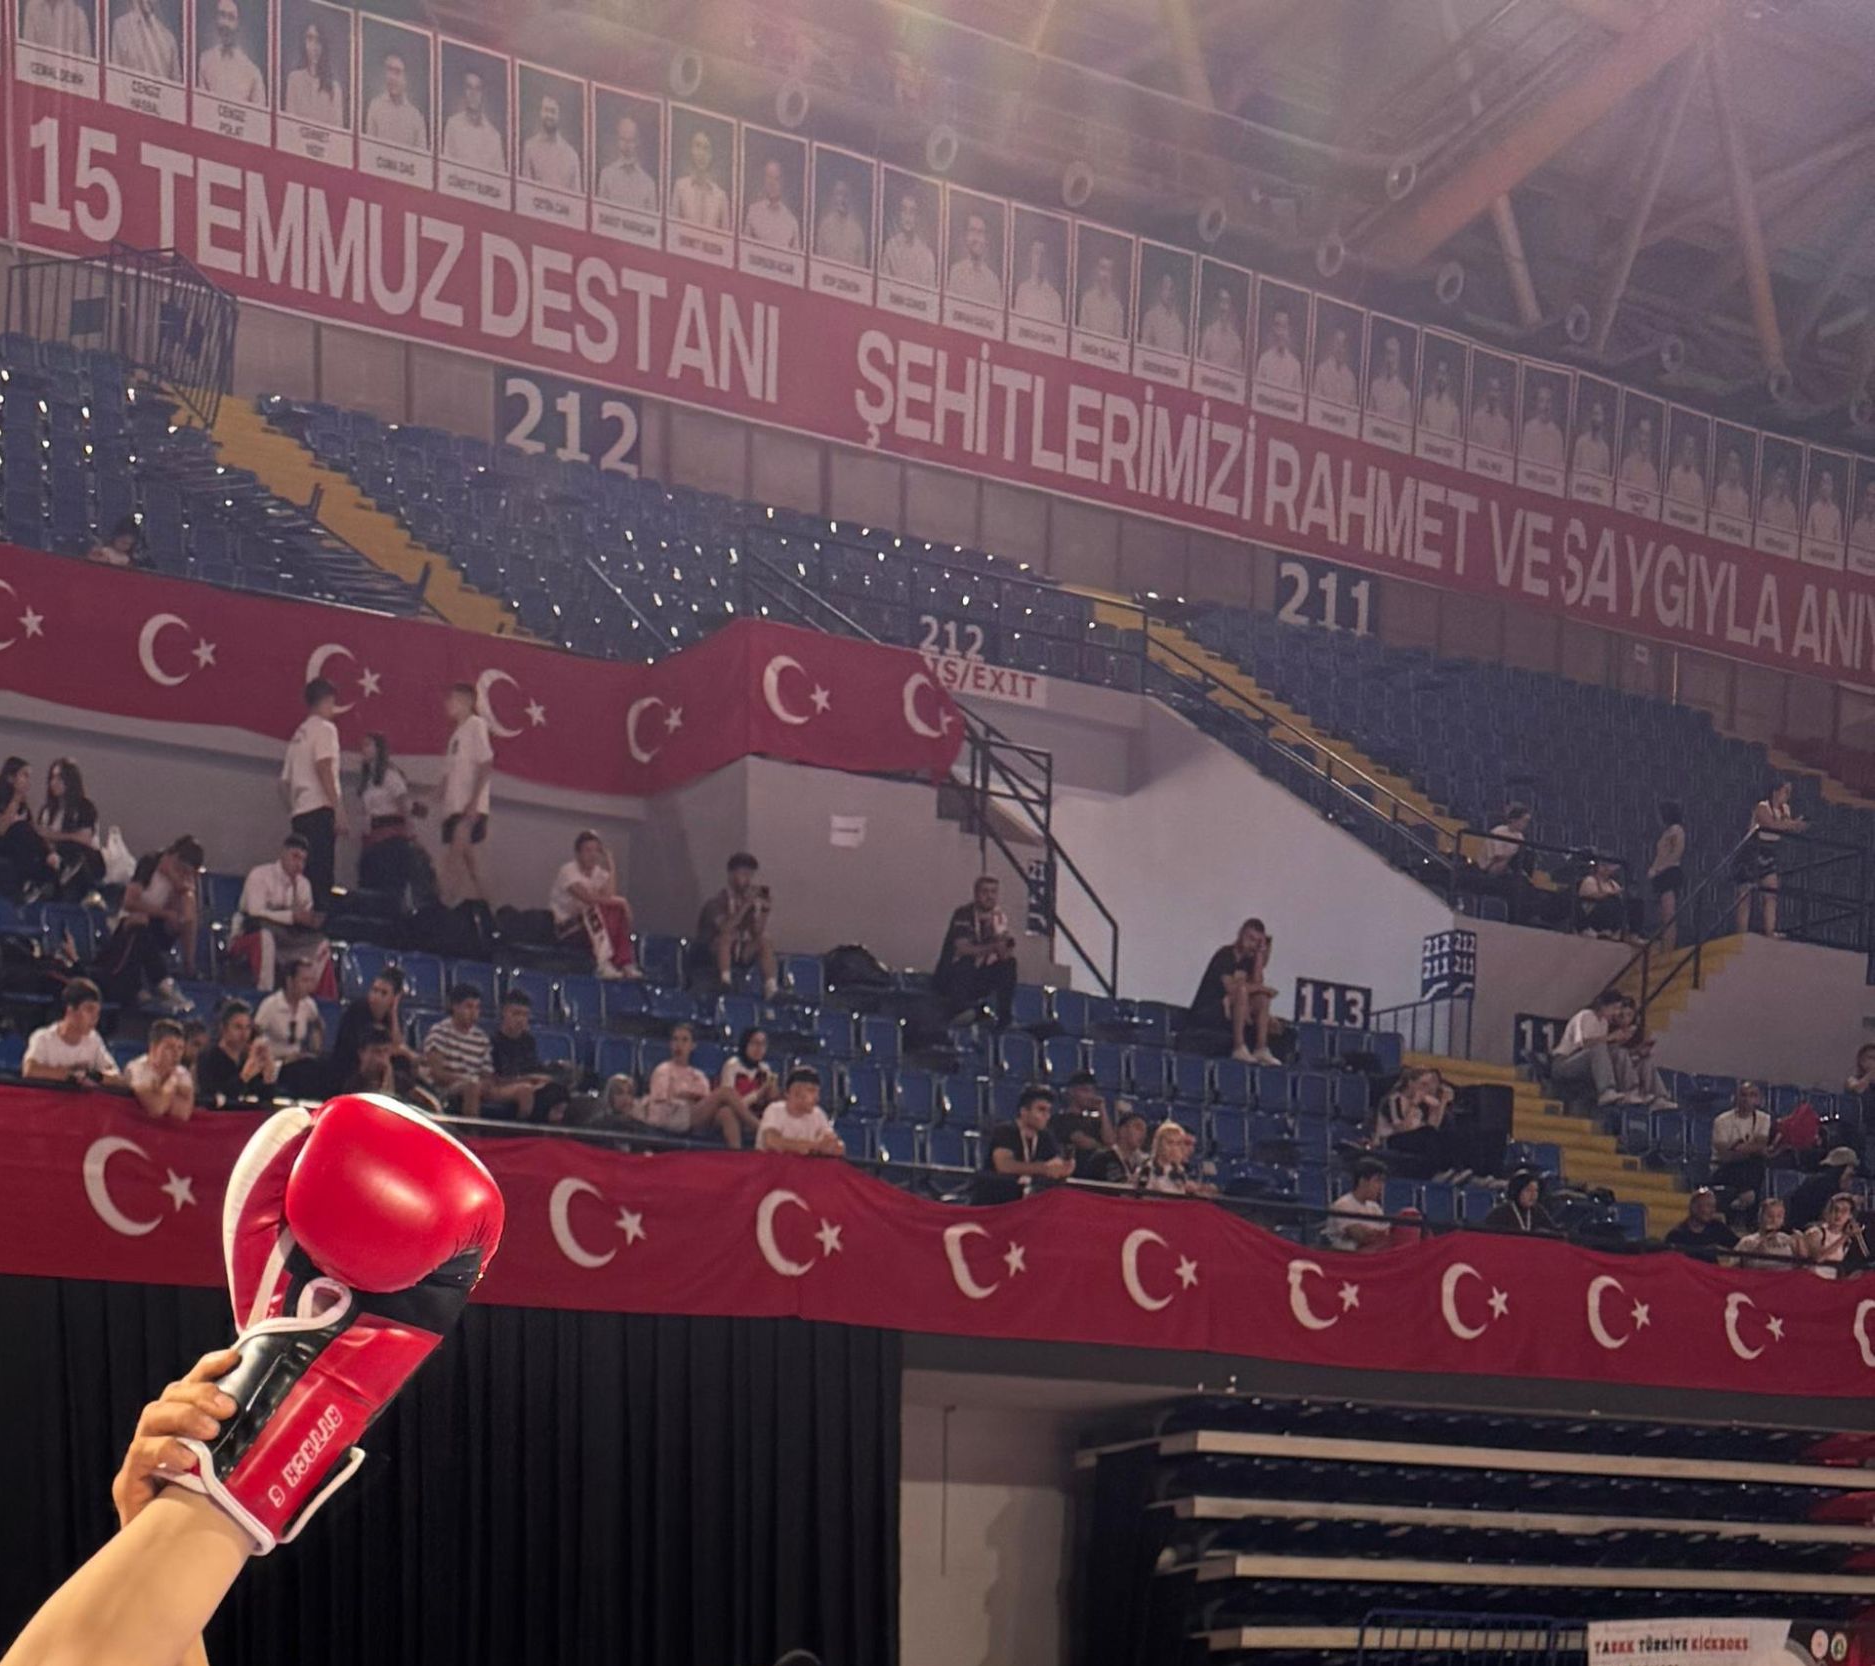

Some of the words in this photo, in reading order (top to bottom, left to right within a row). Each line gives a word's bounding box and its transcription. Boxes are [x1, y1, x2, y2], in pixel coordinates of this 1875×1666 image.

[29, 116, 123, 242] 15
[140, 142, 465, 330] TEMMUZ
[480, 231, 779, 404] DESTANI
[855, 329, 1257, 520] ŞEHİTLERİMİZİ
[1264, 438, 1480, 576] RAHMET
[1489, 501, 1554, 598] VE
[1559, 517, 1784, 653] SAYGIYLA
[505, 378, 639, 478] 212
[1277, 562, 1375, 638] 211
[919, 615, 986, 661] 212
[1422, 956, 1450, 979] 211
[1423, 934, 1451, 957] 212
[1298, 983, 1366, 1031] 113
[281, 1403, 345, 1490] ATTACK
